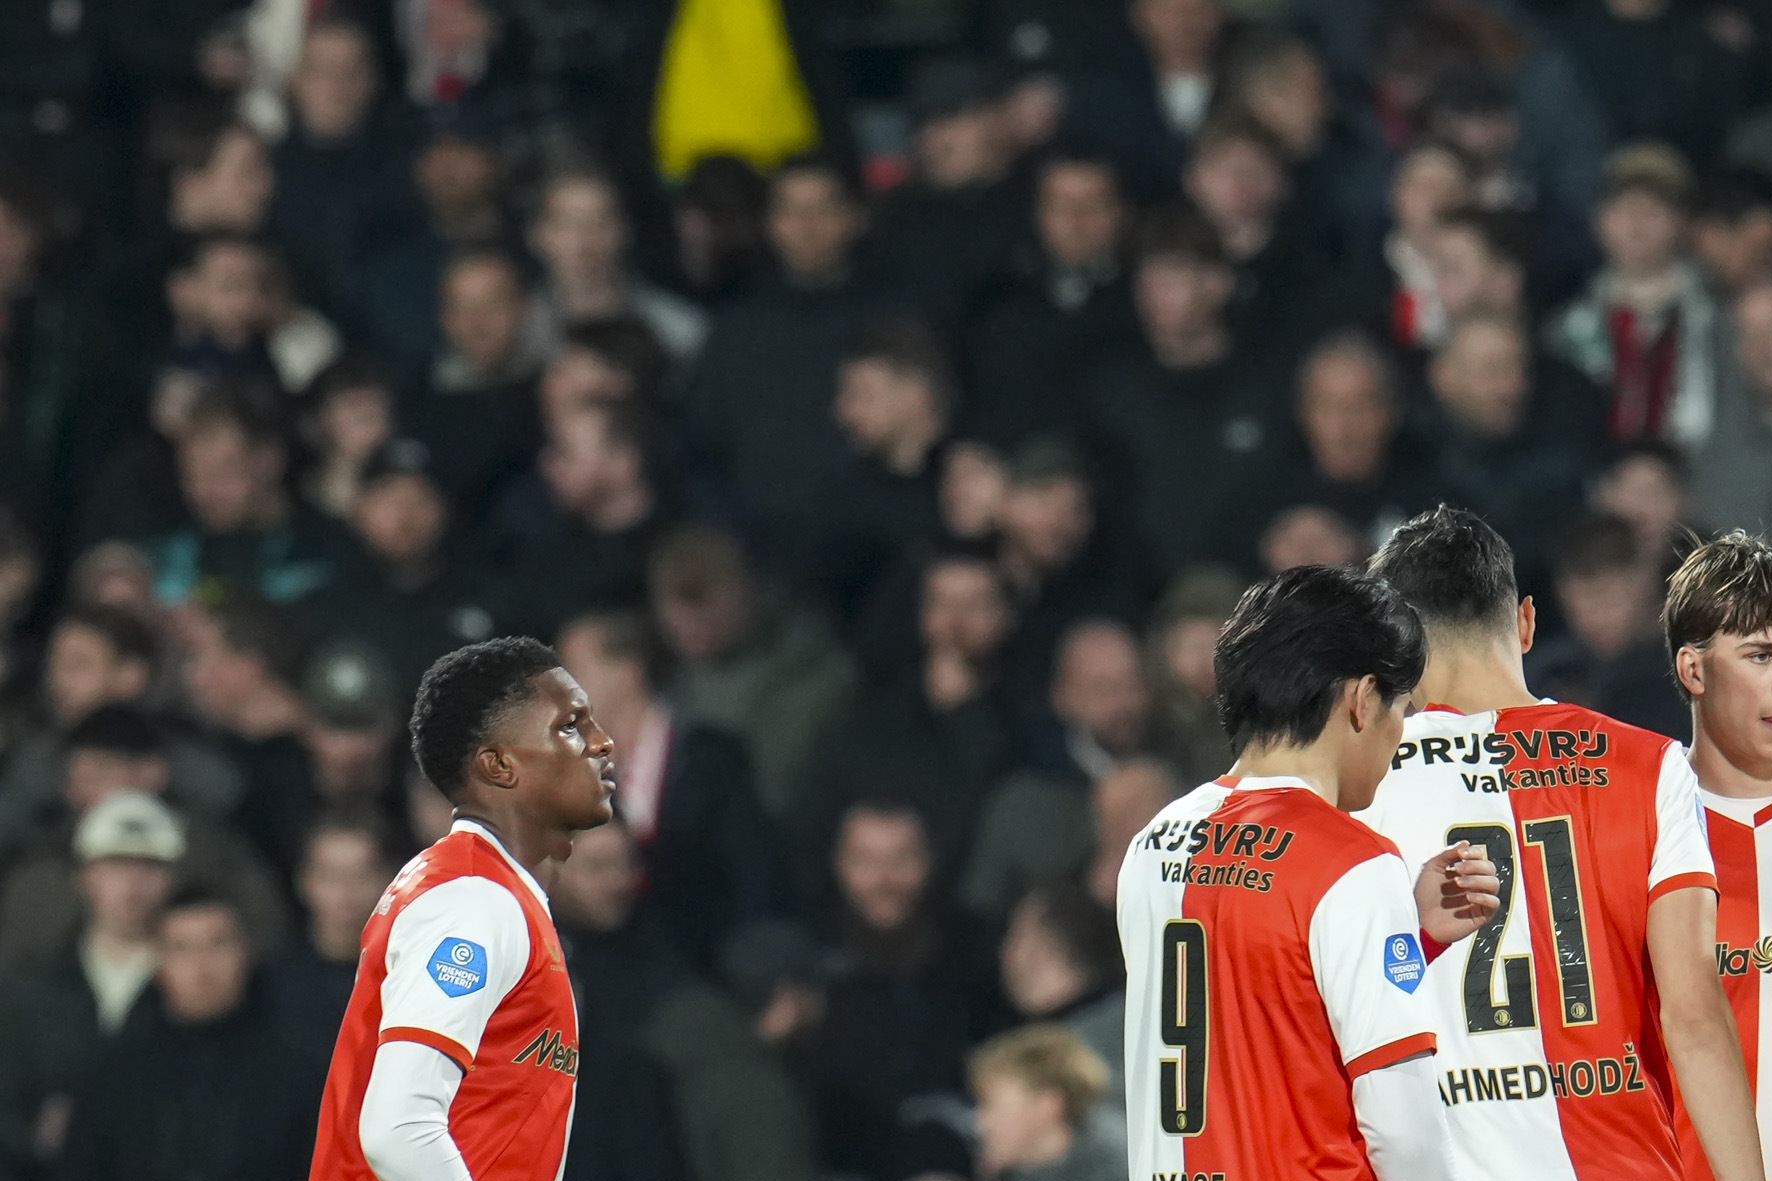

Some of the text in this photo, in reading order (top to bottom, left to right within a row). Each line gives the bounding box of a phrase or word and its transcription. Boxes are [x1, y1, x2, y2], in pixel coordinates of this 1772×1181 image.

[1391, 728, 1608, 770] PRIJSVRIJ
[1461, 762, 1609, 793] vakanties
[1161, 857, 1275, 893] vakanties
[1445, 814, 1599, 1036] 21
[436, 963, 480, 983] VRIENDEN
[438, 973, 473, 989] LOTERIJ
[1161, 918, 1209, 1137] 9
